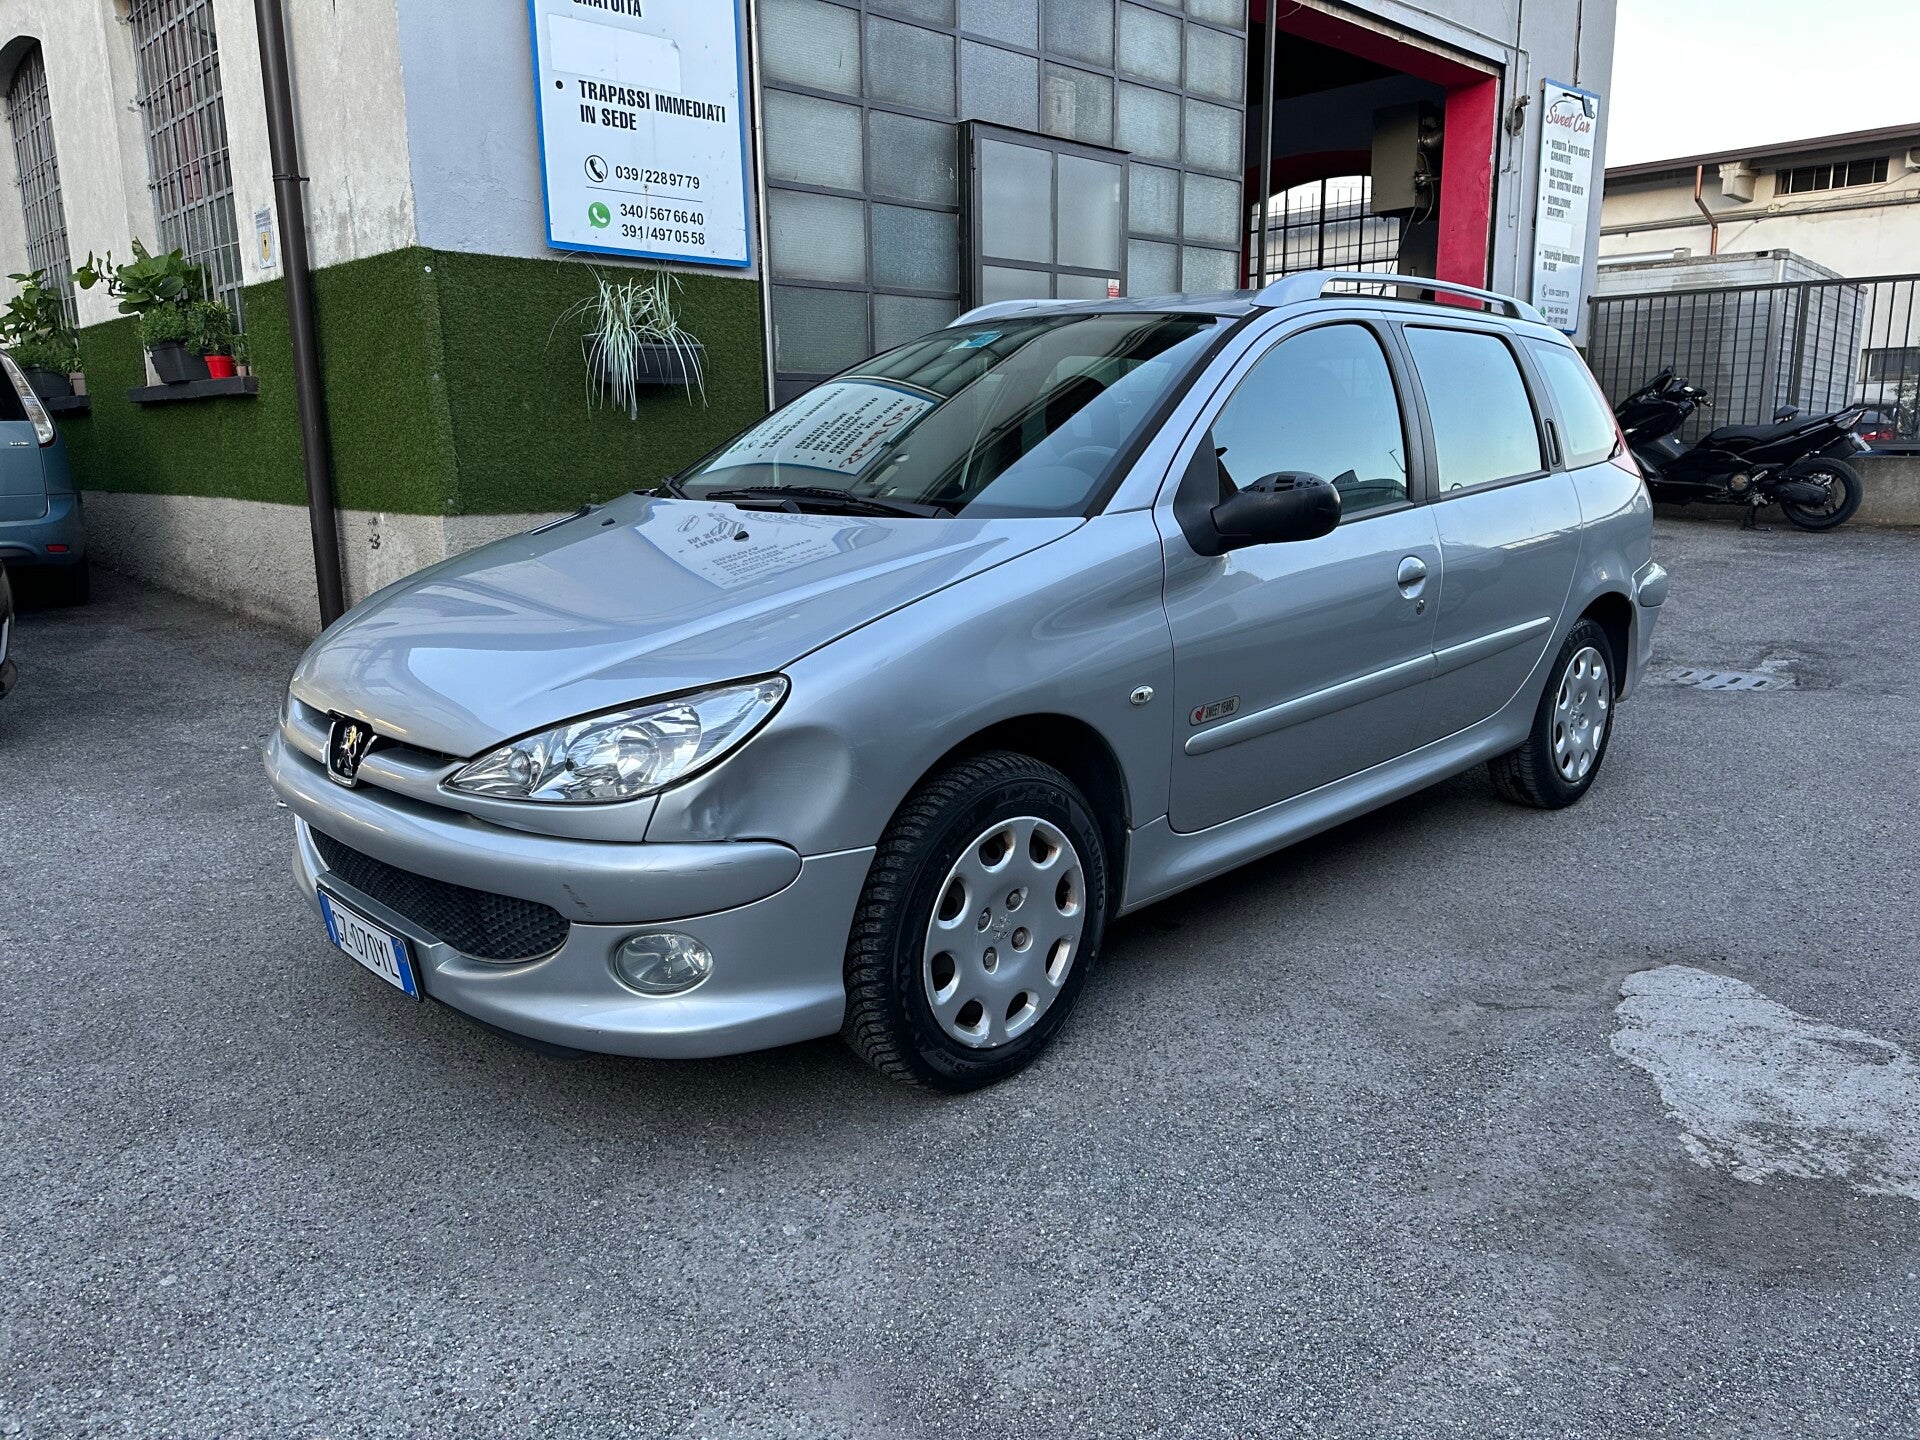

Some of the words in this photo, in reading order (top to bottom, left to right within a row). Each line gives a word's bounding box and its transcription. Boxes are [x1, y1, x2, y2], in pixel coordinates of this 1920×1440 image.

[573, 0, 642, 17] TUITA
[578, 79, 651, 110] TRAPASSI
[655, 93, 726, 123] IMMEDIATI
[580, 104, 596, 124] IN
[601, 108, 637, 131] SEDE
[1546, 101, 1575, 128] Sweet
[1573, 113, 1590, 133] Car
[615, 165, 700, 190] 039/2289779
[620, 203, 704, 226] 340/5676640
[621, 223, 705, 246] 391/4970558
